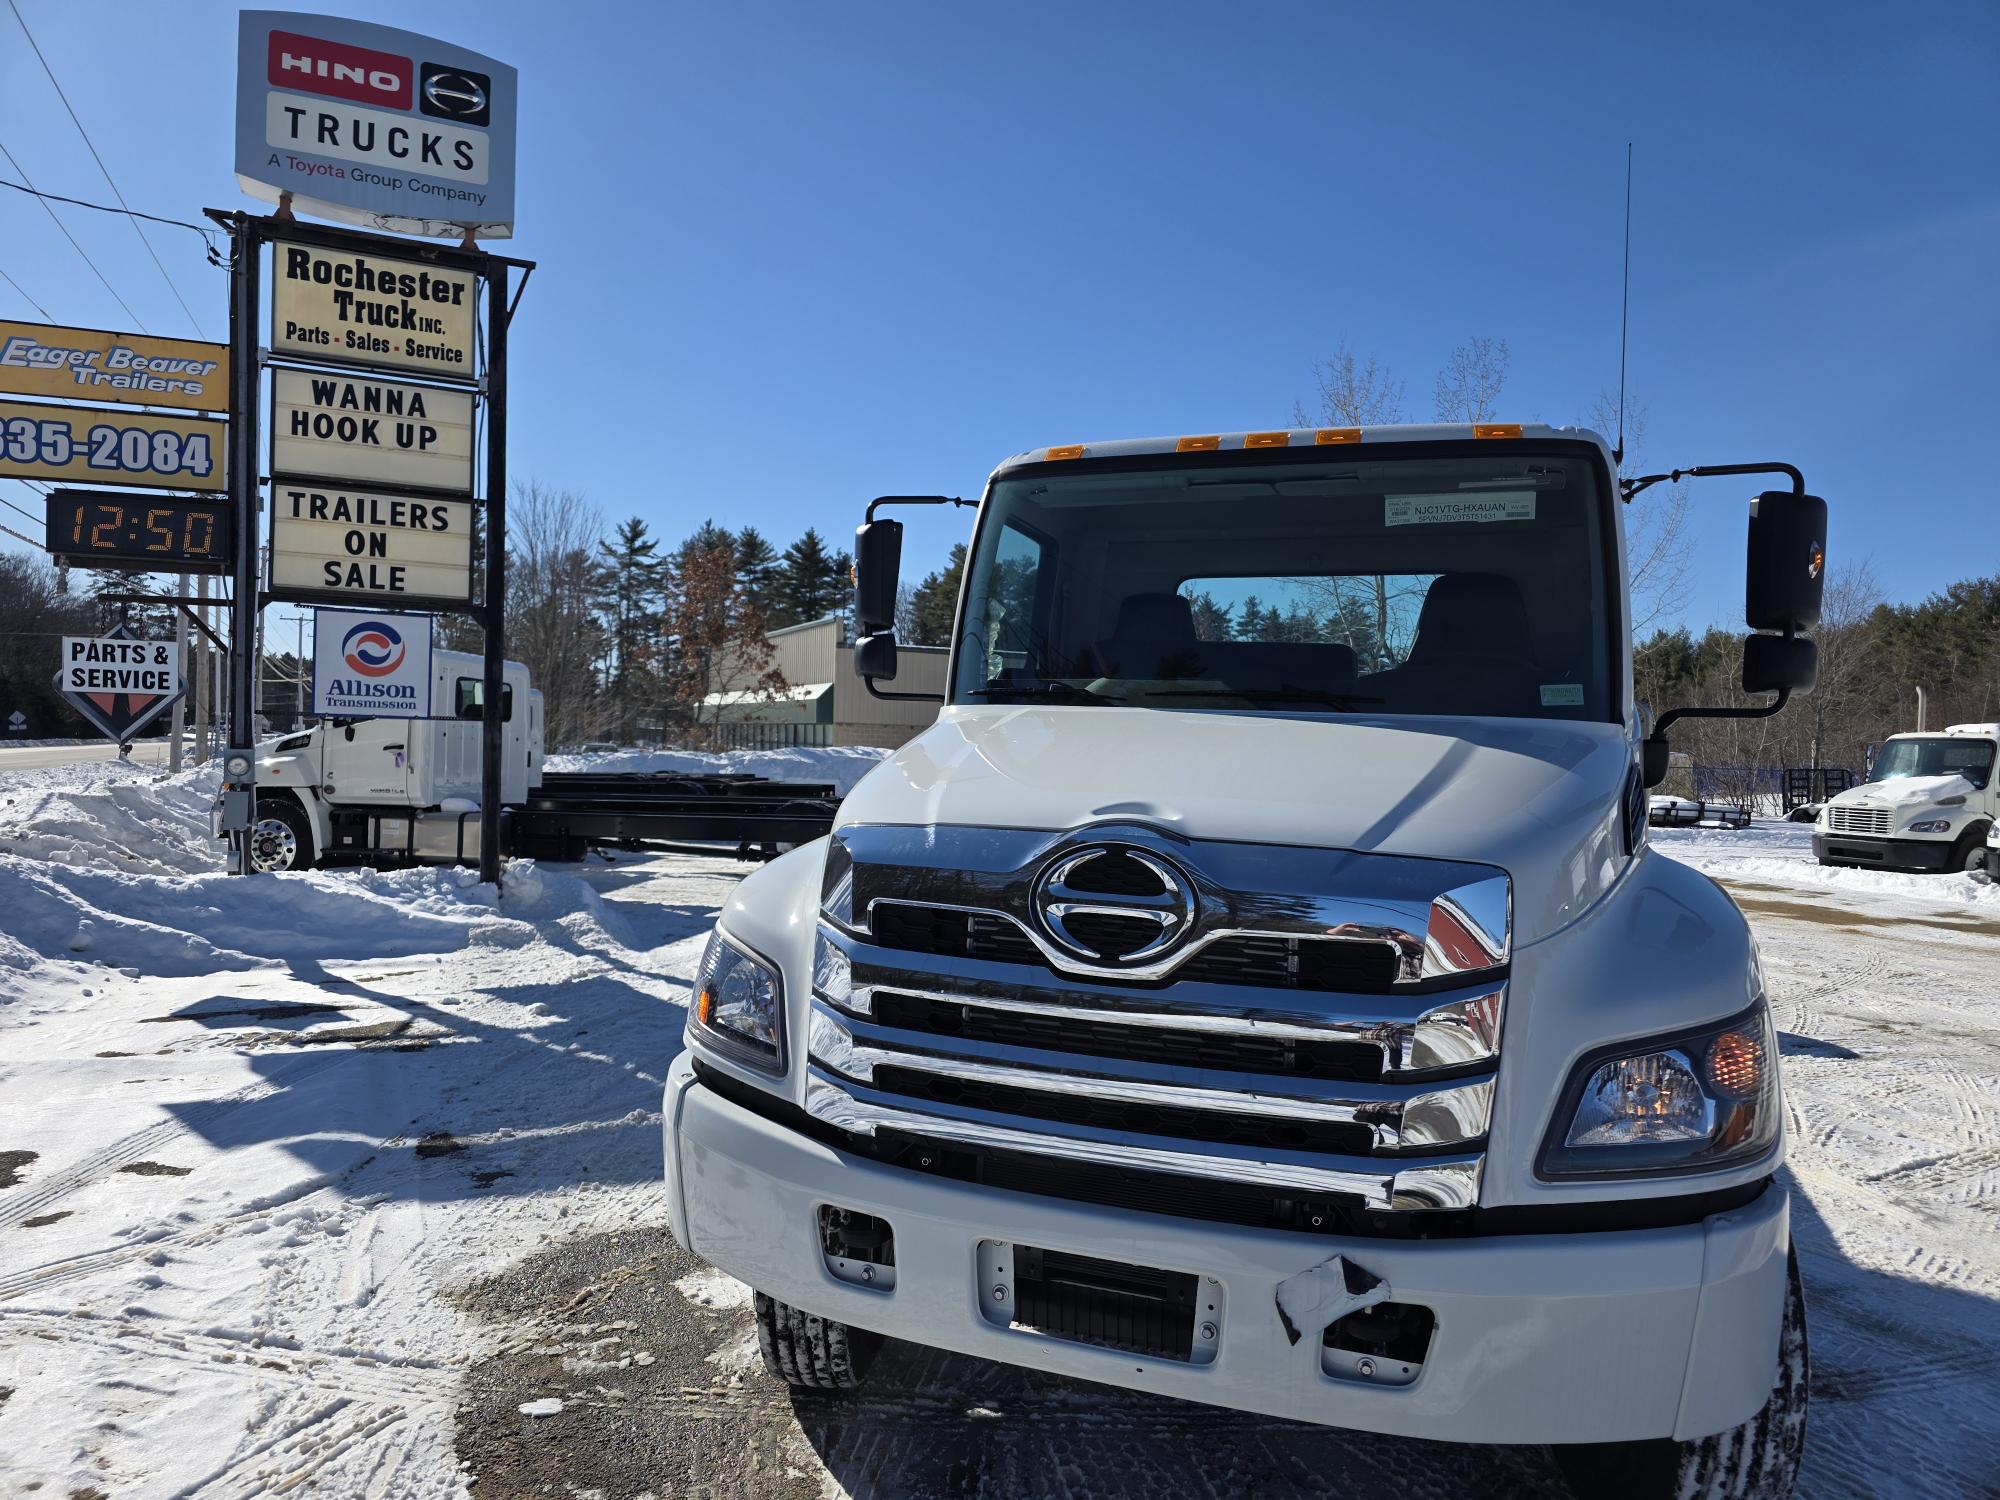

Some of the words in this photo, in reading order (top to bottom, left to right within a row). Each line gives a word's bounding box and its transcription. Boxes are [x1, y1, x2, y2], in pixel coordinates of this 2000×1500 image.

[281, 52, 400, 92] HINO
[283, 106, 474, 171] TRUCKS
[268, 153, 281, 168] A
[286, 156, 345, 179] Toyota
[351, 168, 403, 190] Group
[408, 178, 487, 206] Company
[286, 247, 465, 306] Rochester
[333, 289, 417, 331] Truck
[419, 317, 446, 335] INC.
[1, 336, 100, 370] Eager
[107, 347, 218, 377] Beaver
[286, 320, 330, 345] Parts
[345, 330, 390, 353] Sales
[405, 338, 463, 363] Service
[72, 366, 204, 396] Trailers
[311, 379, 427, 418] WANNA
[0, 418, 211, 476] 35-2084
[291, 410, 380, 445] HOOK
[396, 422, 438, 450] UP
[72, 505, 215, 554] 12:50
[287, 491, 449, 532] TRAILERS
[344, 529, 387, 558] ON
[323, 560, 406, 592] SALE
[71, 642, 146, 664] PARTS
[153, 645, 169, 665] &
[71, 667, 170, 690] SERVICE
[326, 679, 417, 699] Allison
[325, 696, 417, 710] Transmission
